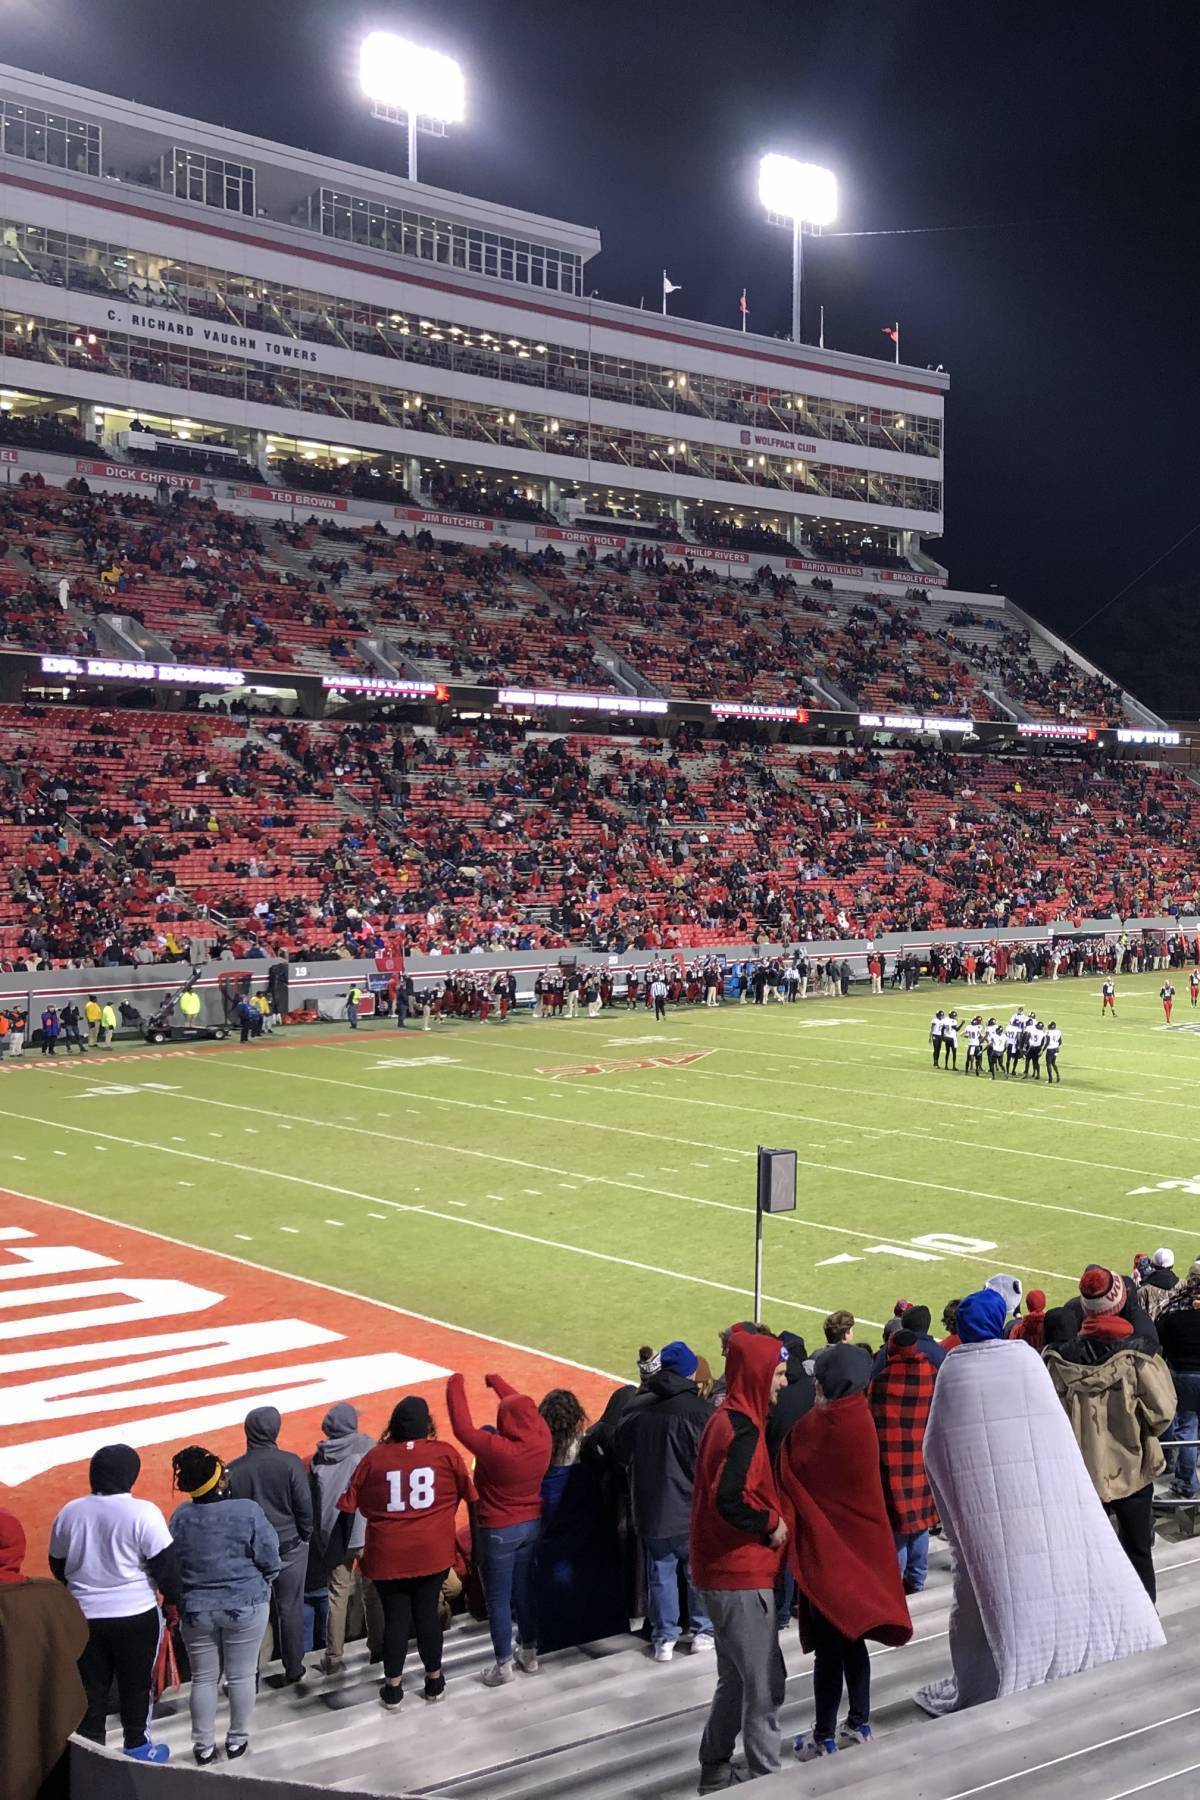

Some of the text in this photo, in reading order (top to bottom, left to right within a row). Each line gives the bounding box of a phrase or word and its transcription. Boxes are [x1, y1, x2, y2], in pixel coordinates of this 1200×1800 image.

[108, 310, 318, 362] C. RICHARD VAUGHN TOWERS
[754, 435, 796, 450] WOLFPACK
[797, 442, 817, 454] CLUB
[106, 466, 194, 488] DICK CHRISTY
[270, 491, 336, 509] TED BROWN
[421, 513, 486, 529] JIM RITCHER
[560, 531, 618, 546] TORRY HOLT
[684, 546, 745, 562] PHILIP RIVERS
[801, 562, 862, 576] MARIO WILLIAMS
[892, 573, 947, 586] BRADLEY CHUBB
[295, 966, 306, 976] 19
[864, 1234, 998, 1261] 10
[386, 1466, 435, 1512] 18
